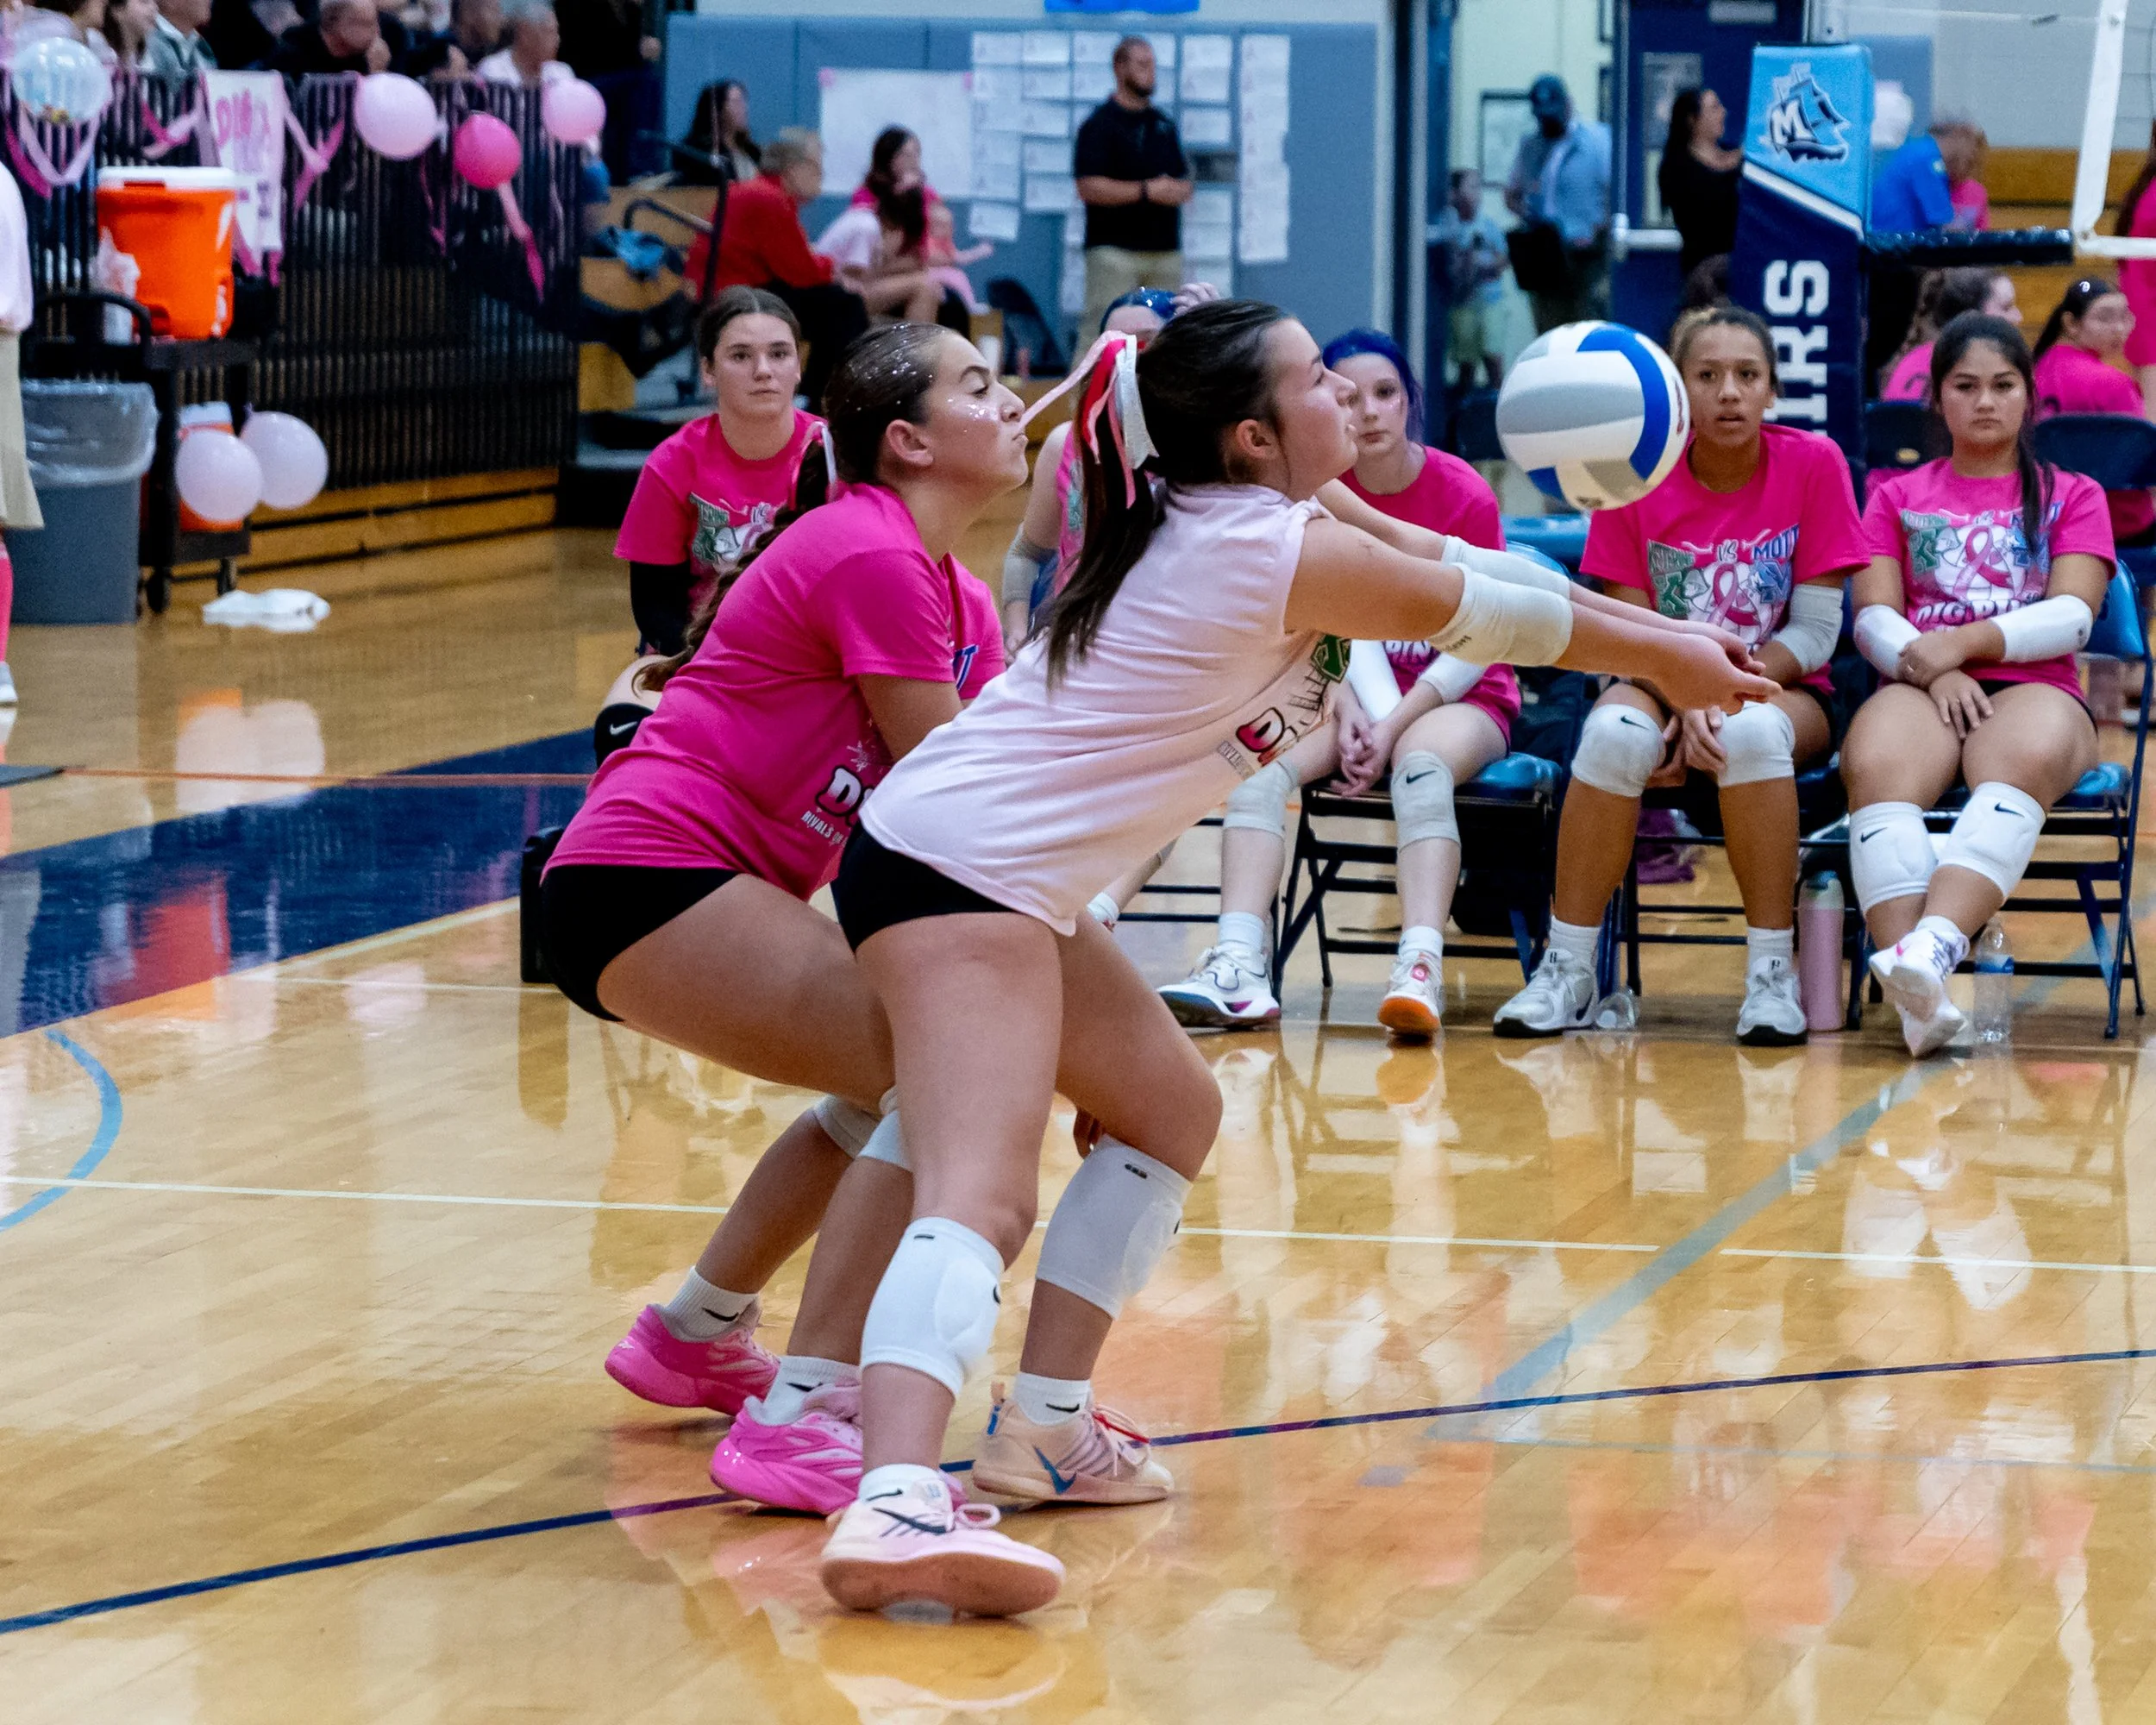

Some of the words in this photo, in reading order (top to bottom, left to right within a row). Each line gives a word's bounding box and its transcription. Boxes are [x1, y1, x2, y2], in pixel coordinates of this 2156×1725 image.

[1764, 260, 1829, 437] IRS
[1717, 540, 1739, 561] VS
[1752, 524, 1800, 561] MOTT
[800, 809, 836, 839] RIVALS
